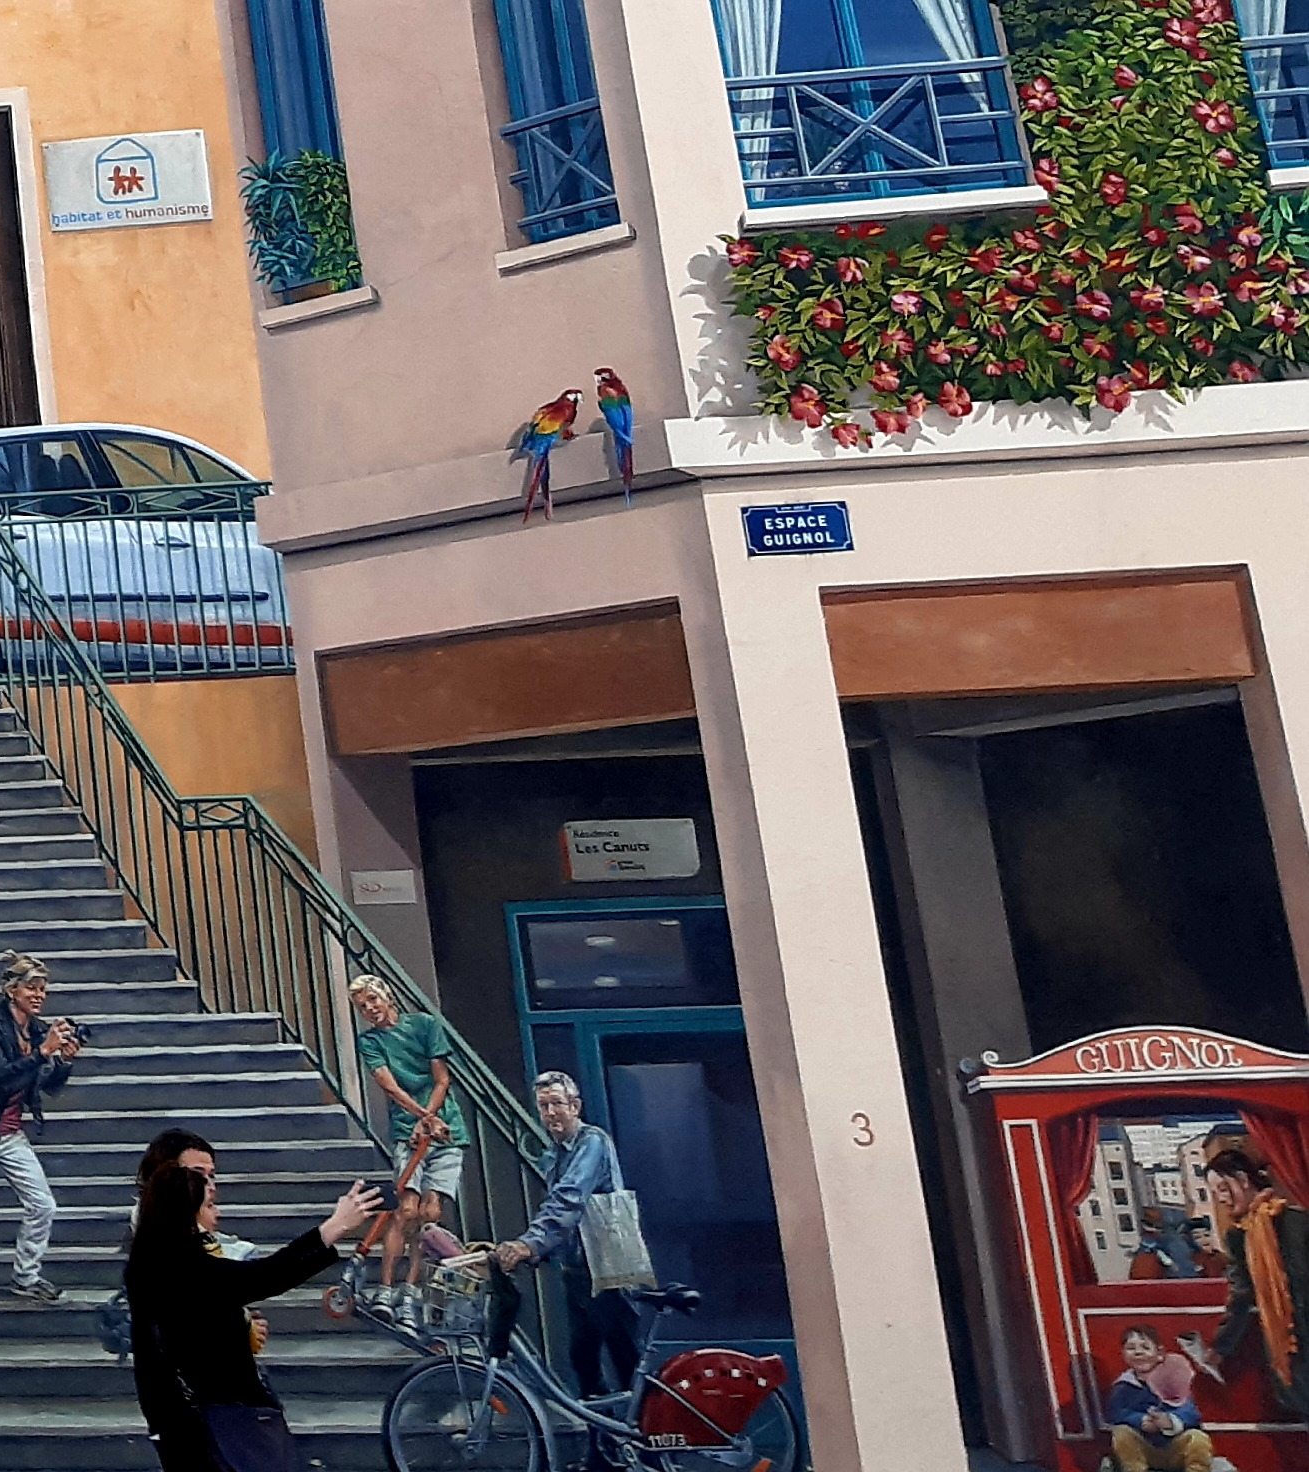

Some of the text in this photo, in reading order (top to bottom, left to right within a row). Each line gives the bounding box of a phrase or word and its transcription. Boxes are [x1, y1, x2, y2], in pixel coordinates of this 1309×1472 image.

[51, 203, 210, 227] habitat et humanisme
[764, 515, 828, 530] ESPACE
[763, 531, 836, 547] GUIGNOL
[575, 841, 650, 854] Les Canuts
[1075, 1035, 1244, 1074] GUIGNOL
[851, 1113, 874, 1147] 3
[647, 1433, 688, 1448] 11073
